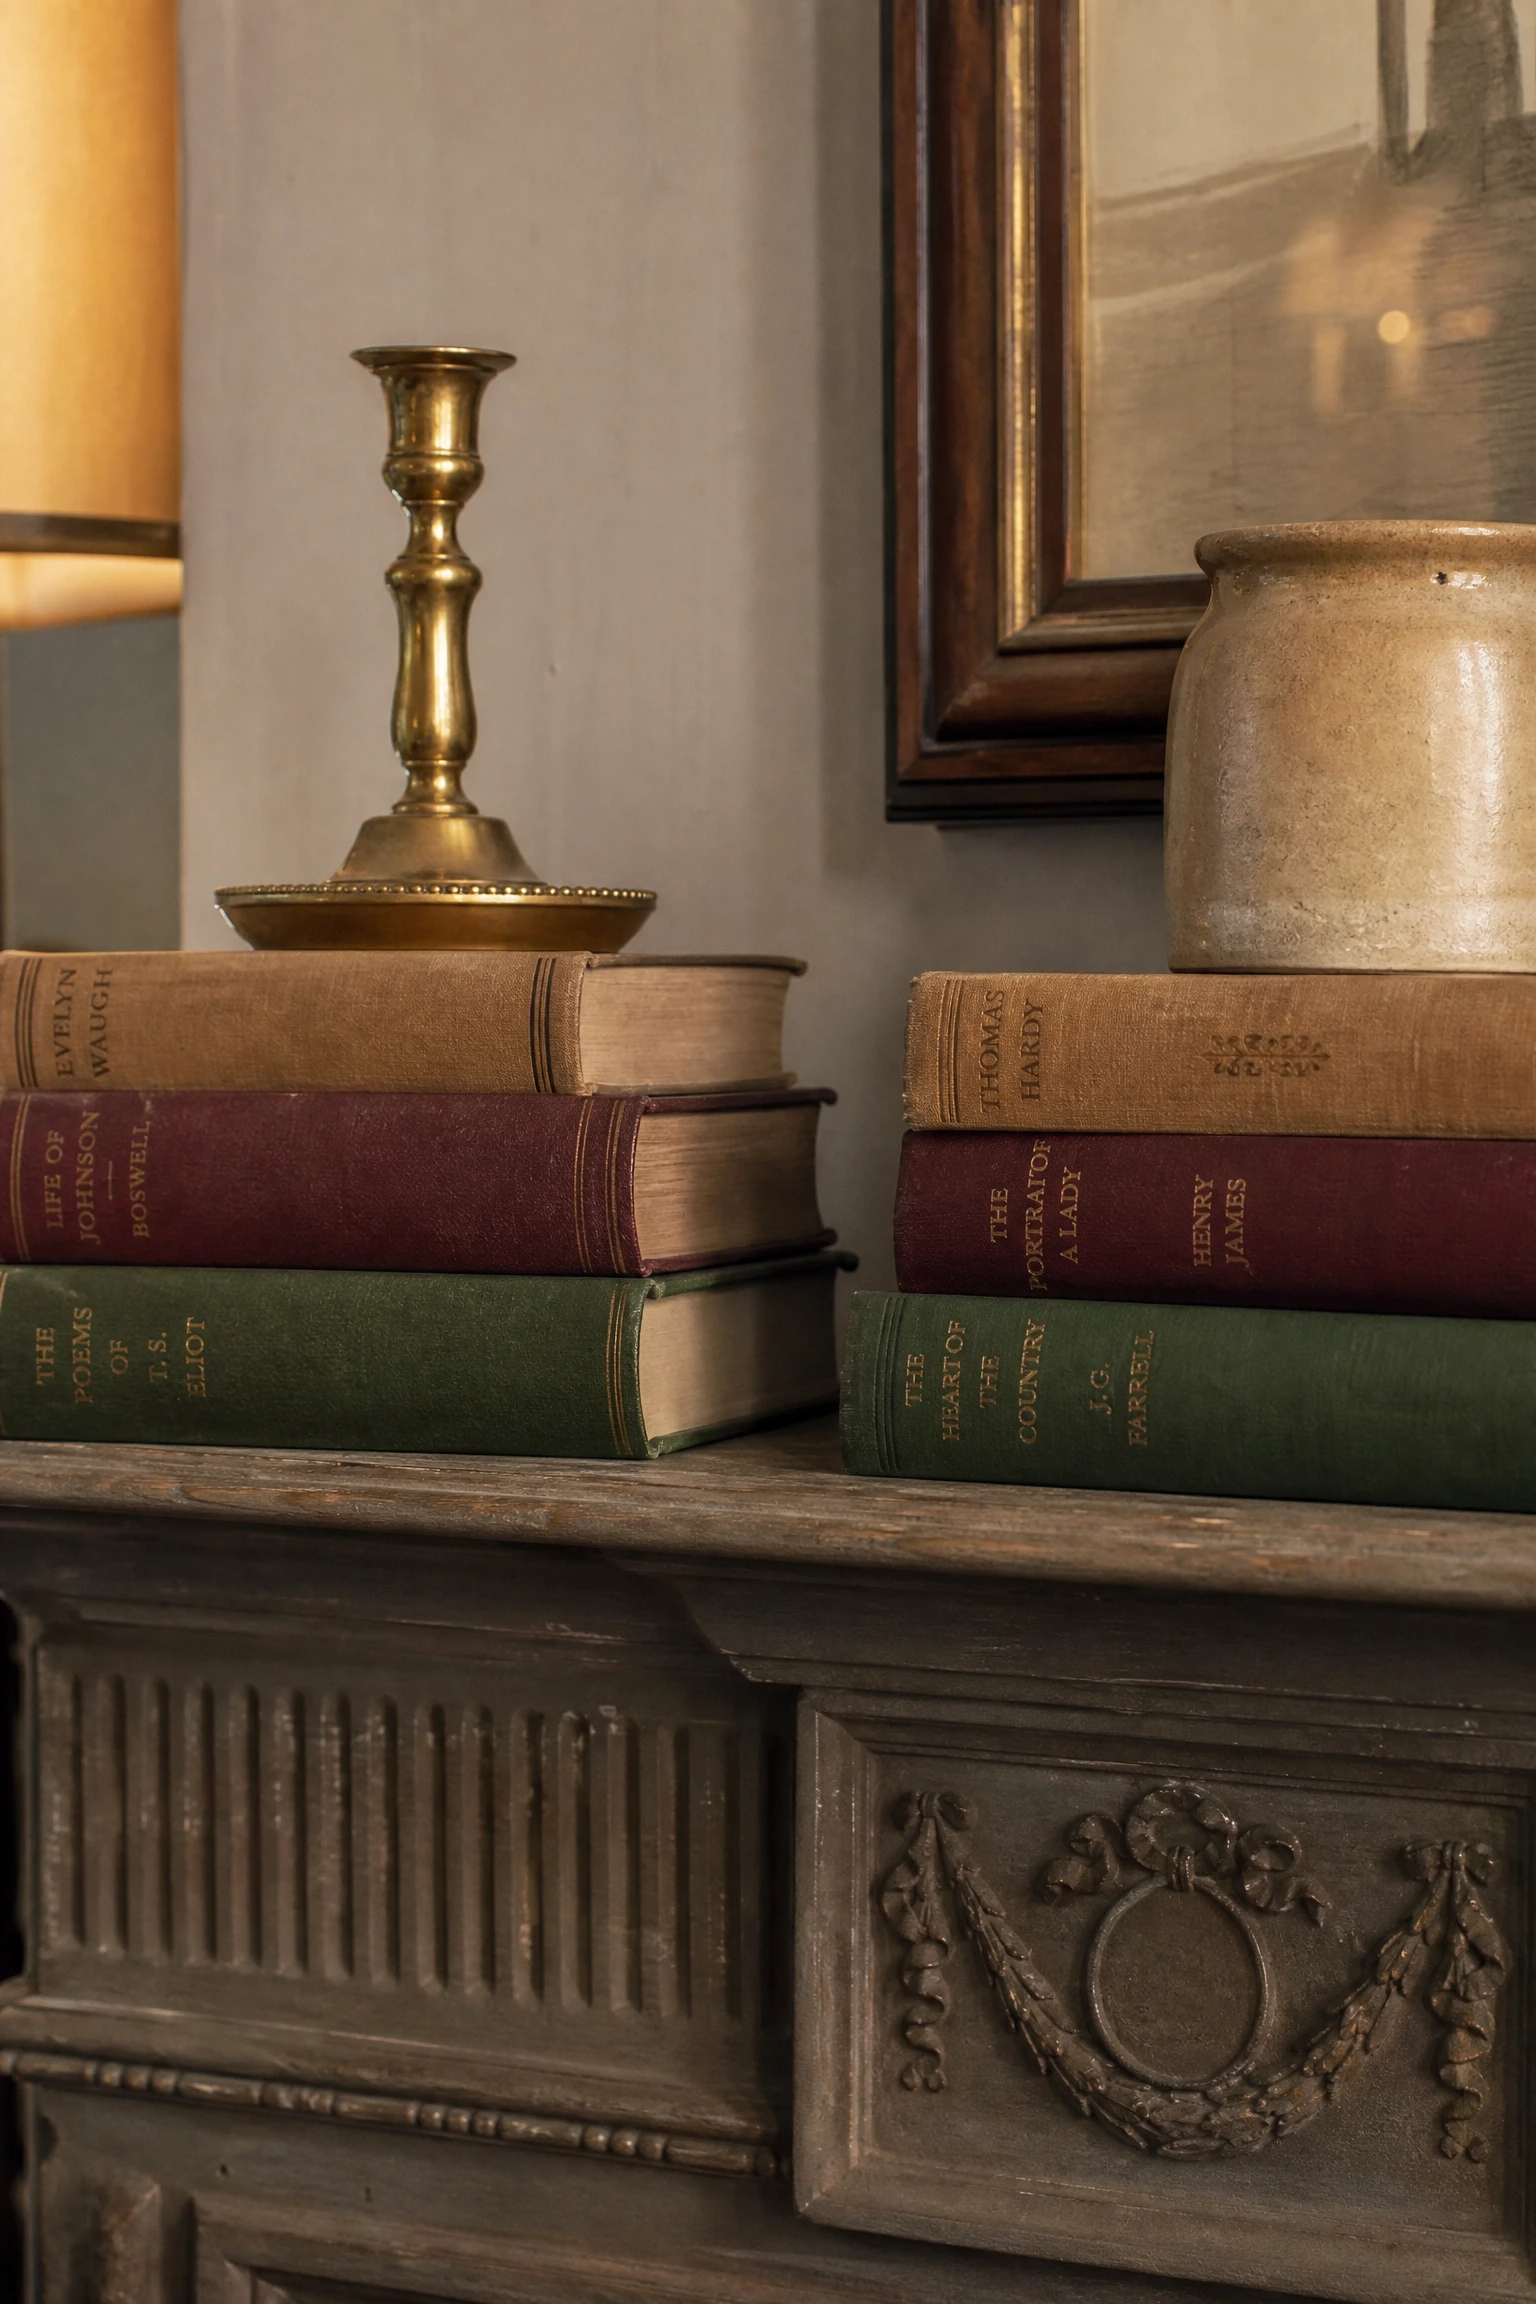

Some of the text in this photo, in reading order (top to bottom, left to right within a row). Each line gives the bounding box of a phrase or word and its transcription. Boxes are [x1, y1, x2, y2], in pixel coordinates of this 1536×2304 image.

[54, 968, 77, 1077] EVELYN
[90, 968, 113, 1078] WAUGH
[980, 990, 1004, 1113] THOMAS
[1020, 998, 1043, 1101] HARDY
[44, 1130, 65, 1229] LIFE OF
[76, 1110, 100, 1245] JOHNSON
[129, 1120, 150, 1238] BOSWELL
[990, 1187, 1008, 1243] THE
[1060, 1166, 1081, 1264] A LADY
[1192, 1174, 1213, 1267] HENRY
[1225, 1178, 1249, 1268] JAMES
[35, 1326, 55, 1385] THE
[72, 1307, 94, 1404] POEMS
[110, 1340, 129, 1375] OF
[185, 1316, 206, 1398] ELIOT
[905, 1353, 925, 1407] THE
[942, 1320, 965, 1441] HEART OF
[979, 1355, 999, 1409] THE
[1018, 1319, 1045, 1444] COUNTRY
[1128, 1330, 1154, 1446] FARRELL
